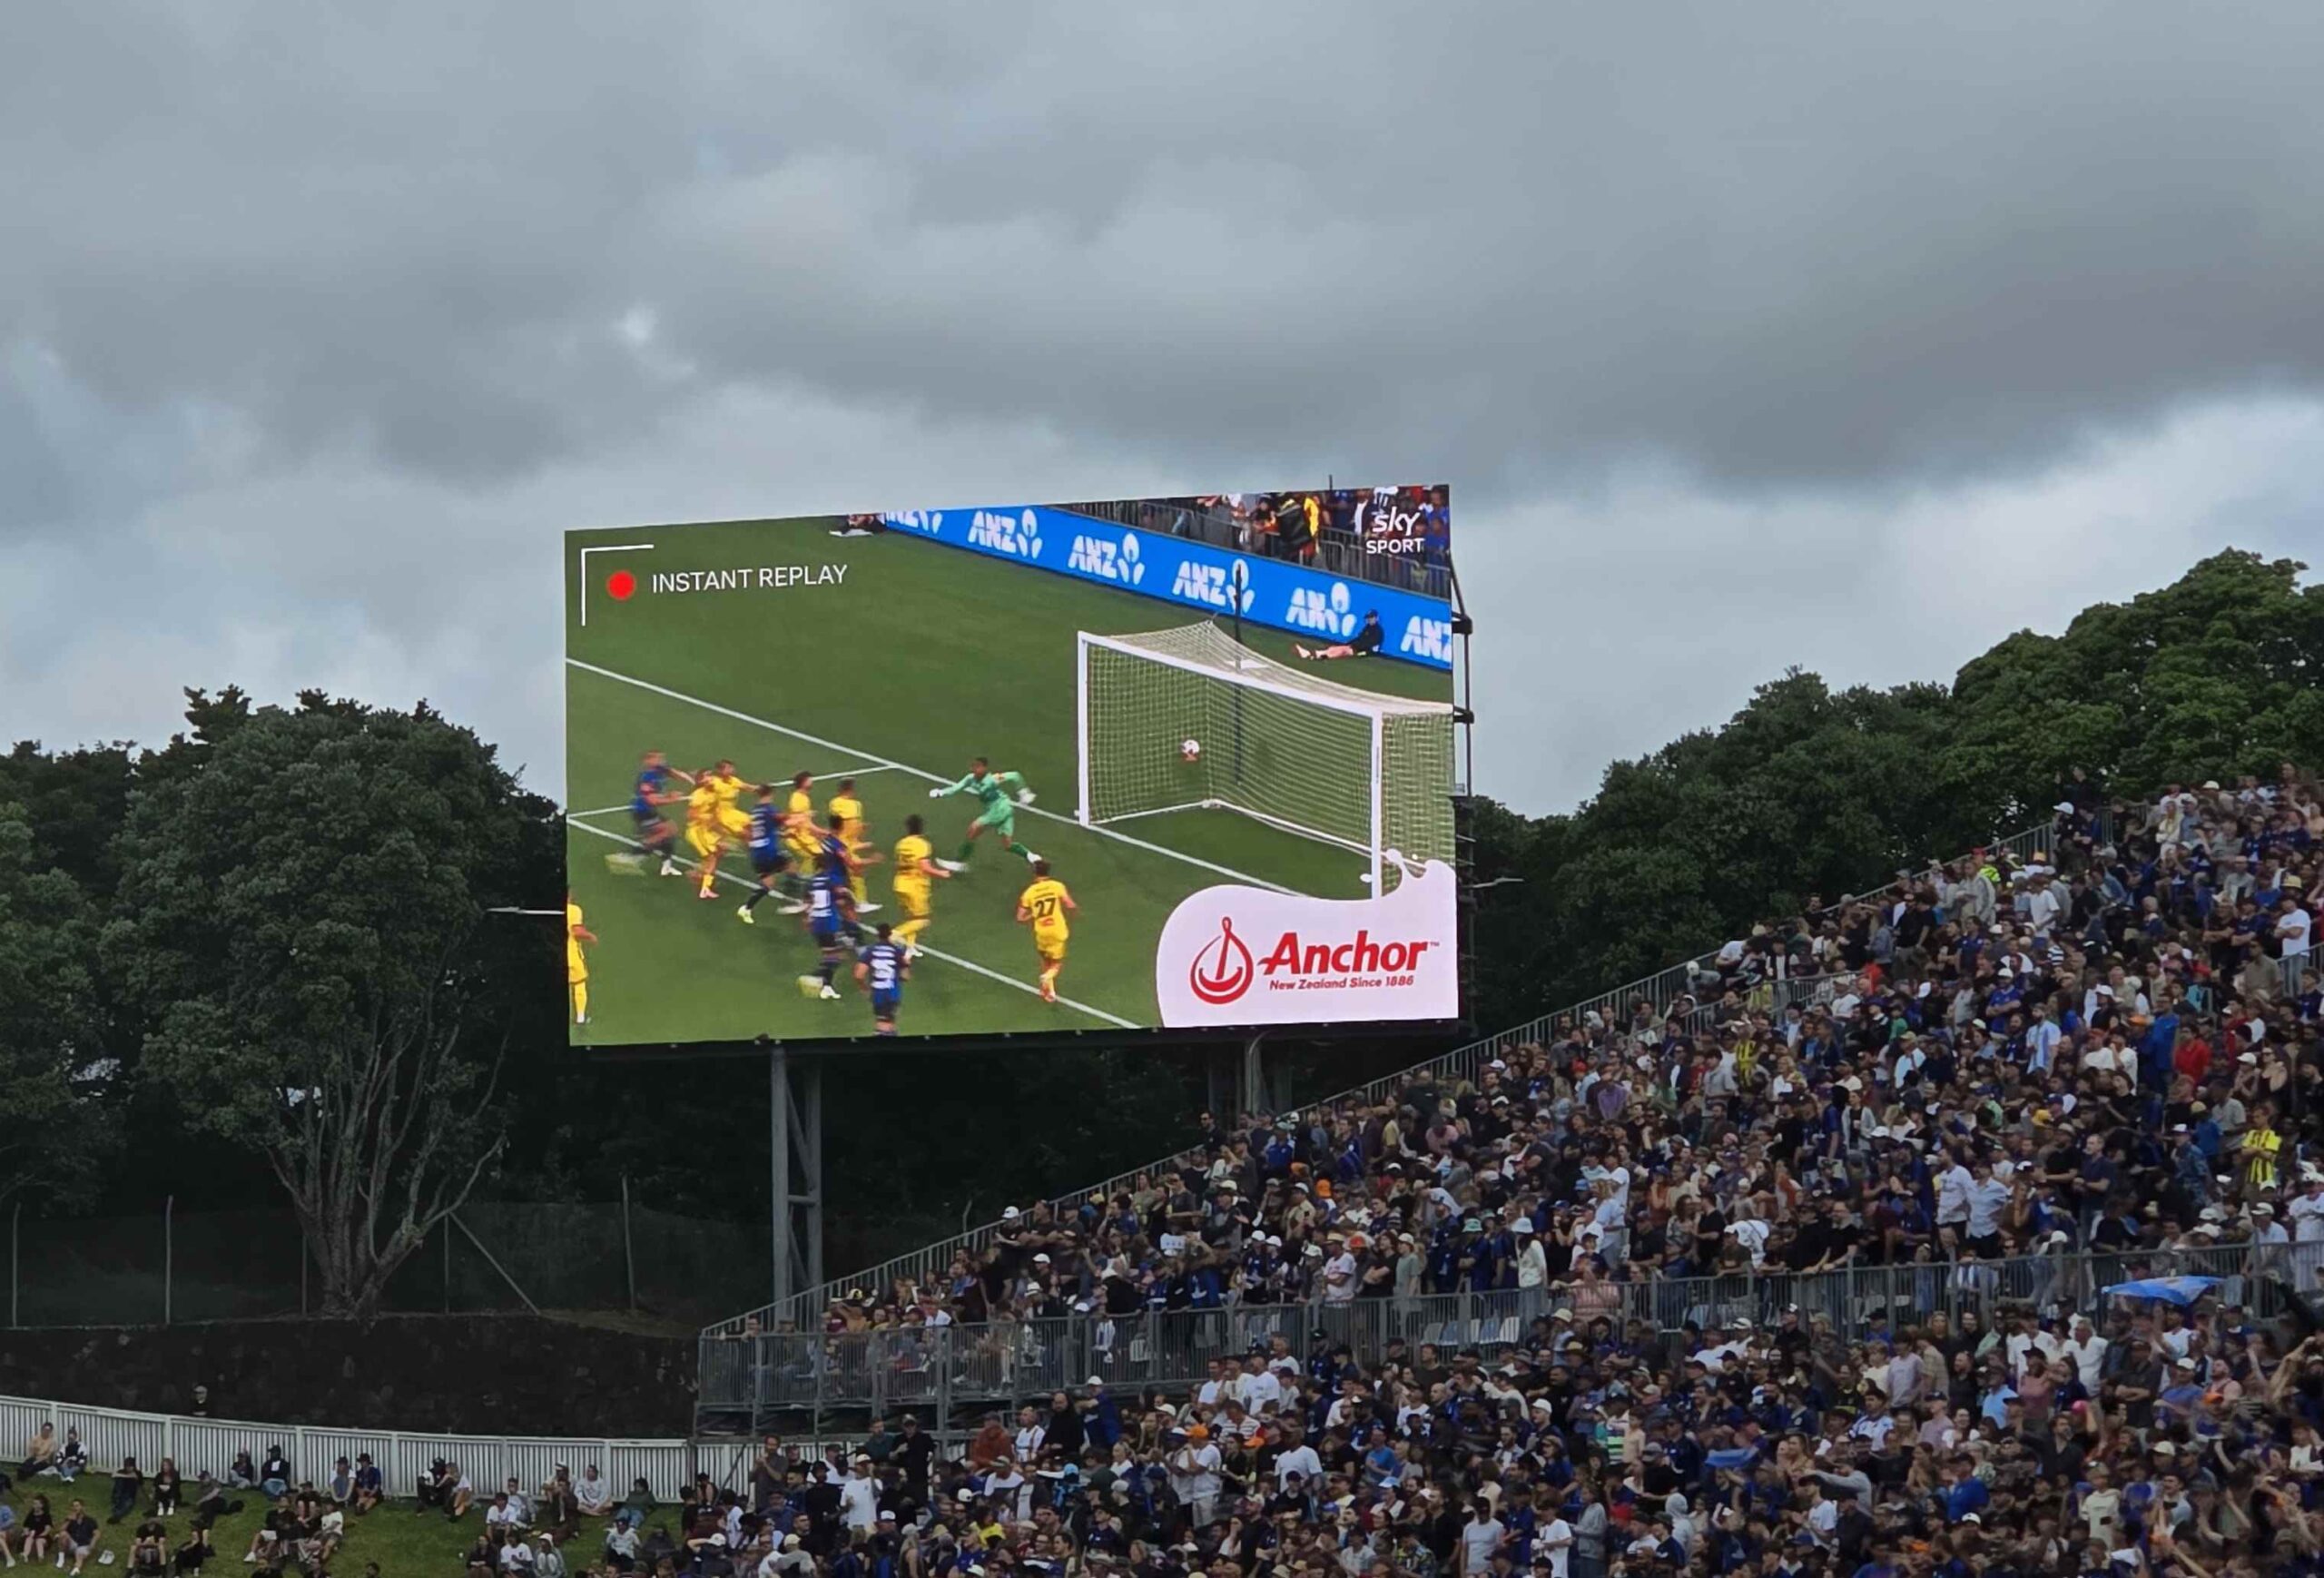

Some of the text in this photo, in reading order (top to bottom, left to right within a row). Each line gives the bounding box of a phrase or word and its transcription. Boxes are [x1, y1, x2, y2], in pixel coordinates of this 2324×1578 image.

[968, 510, 1016, 554] ANZ
[1373, 506, 1422, 536] sky
[1068, 535, 1117, 579] ANZ
[1365, 538, 1425, 554] SPORT
[653, 564, 847, 593] INSTANT REPLAY
[1172, 560, 1226, 606] ANZ
[1034, 897, 1056, 919] 27
[1257, 930, 1428, 975] Anchor
[1270, 975, 1413, 991] New Zealand Since 1886
